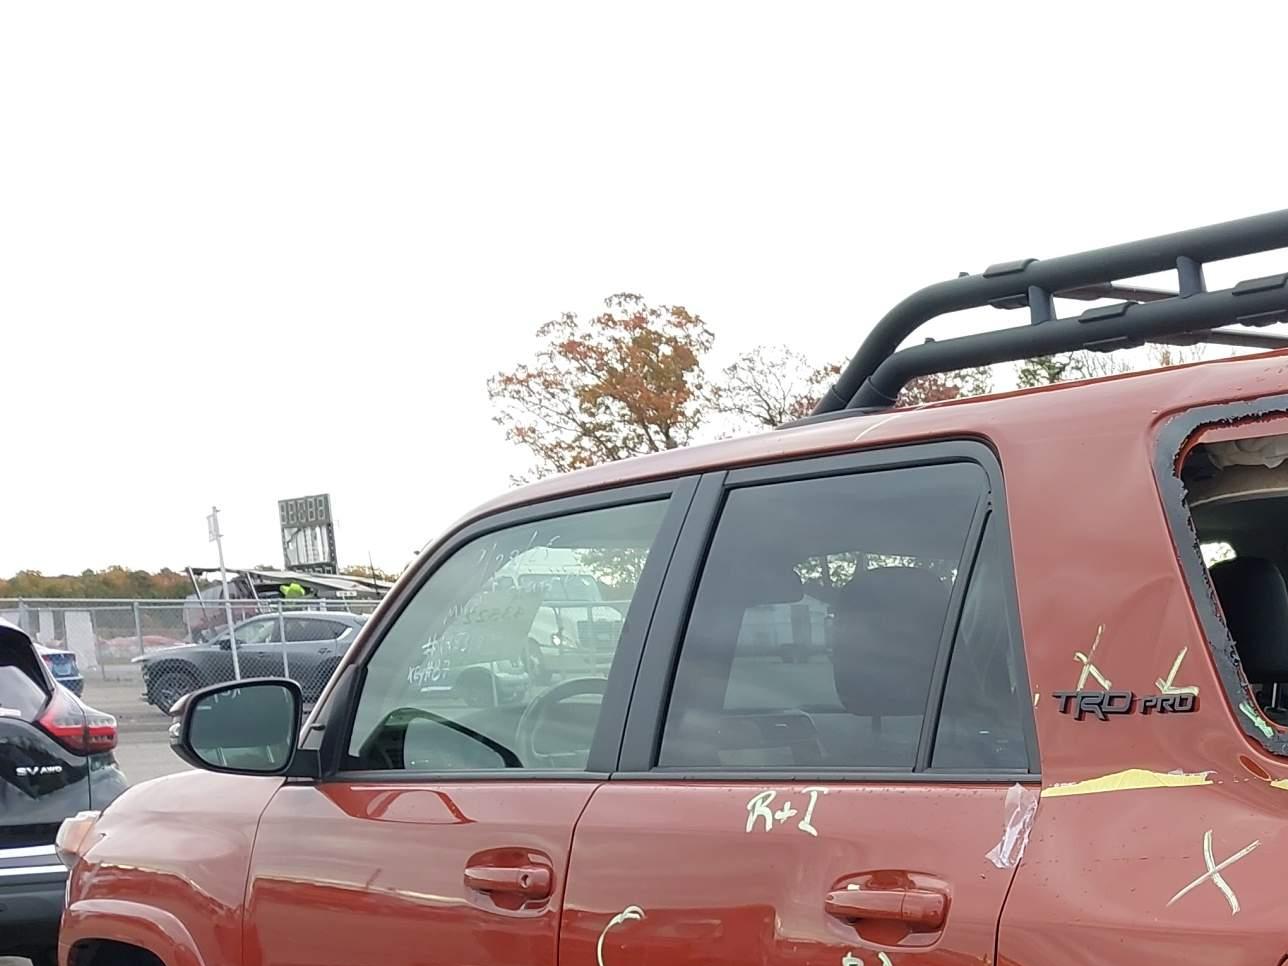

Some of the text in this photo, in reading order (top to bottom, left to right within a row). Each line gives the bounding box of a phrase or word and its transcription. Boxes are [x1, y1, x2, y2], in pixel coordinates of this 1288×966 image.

[1053, 690, 1200, 721] TRD PRO
[15, 765, 63, 777] SV AWD
